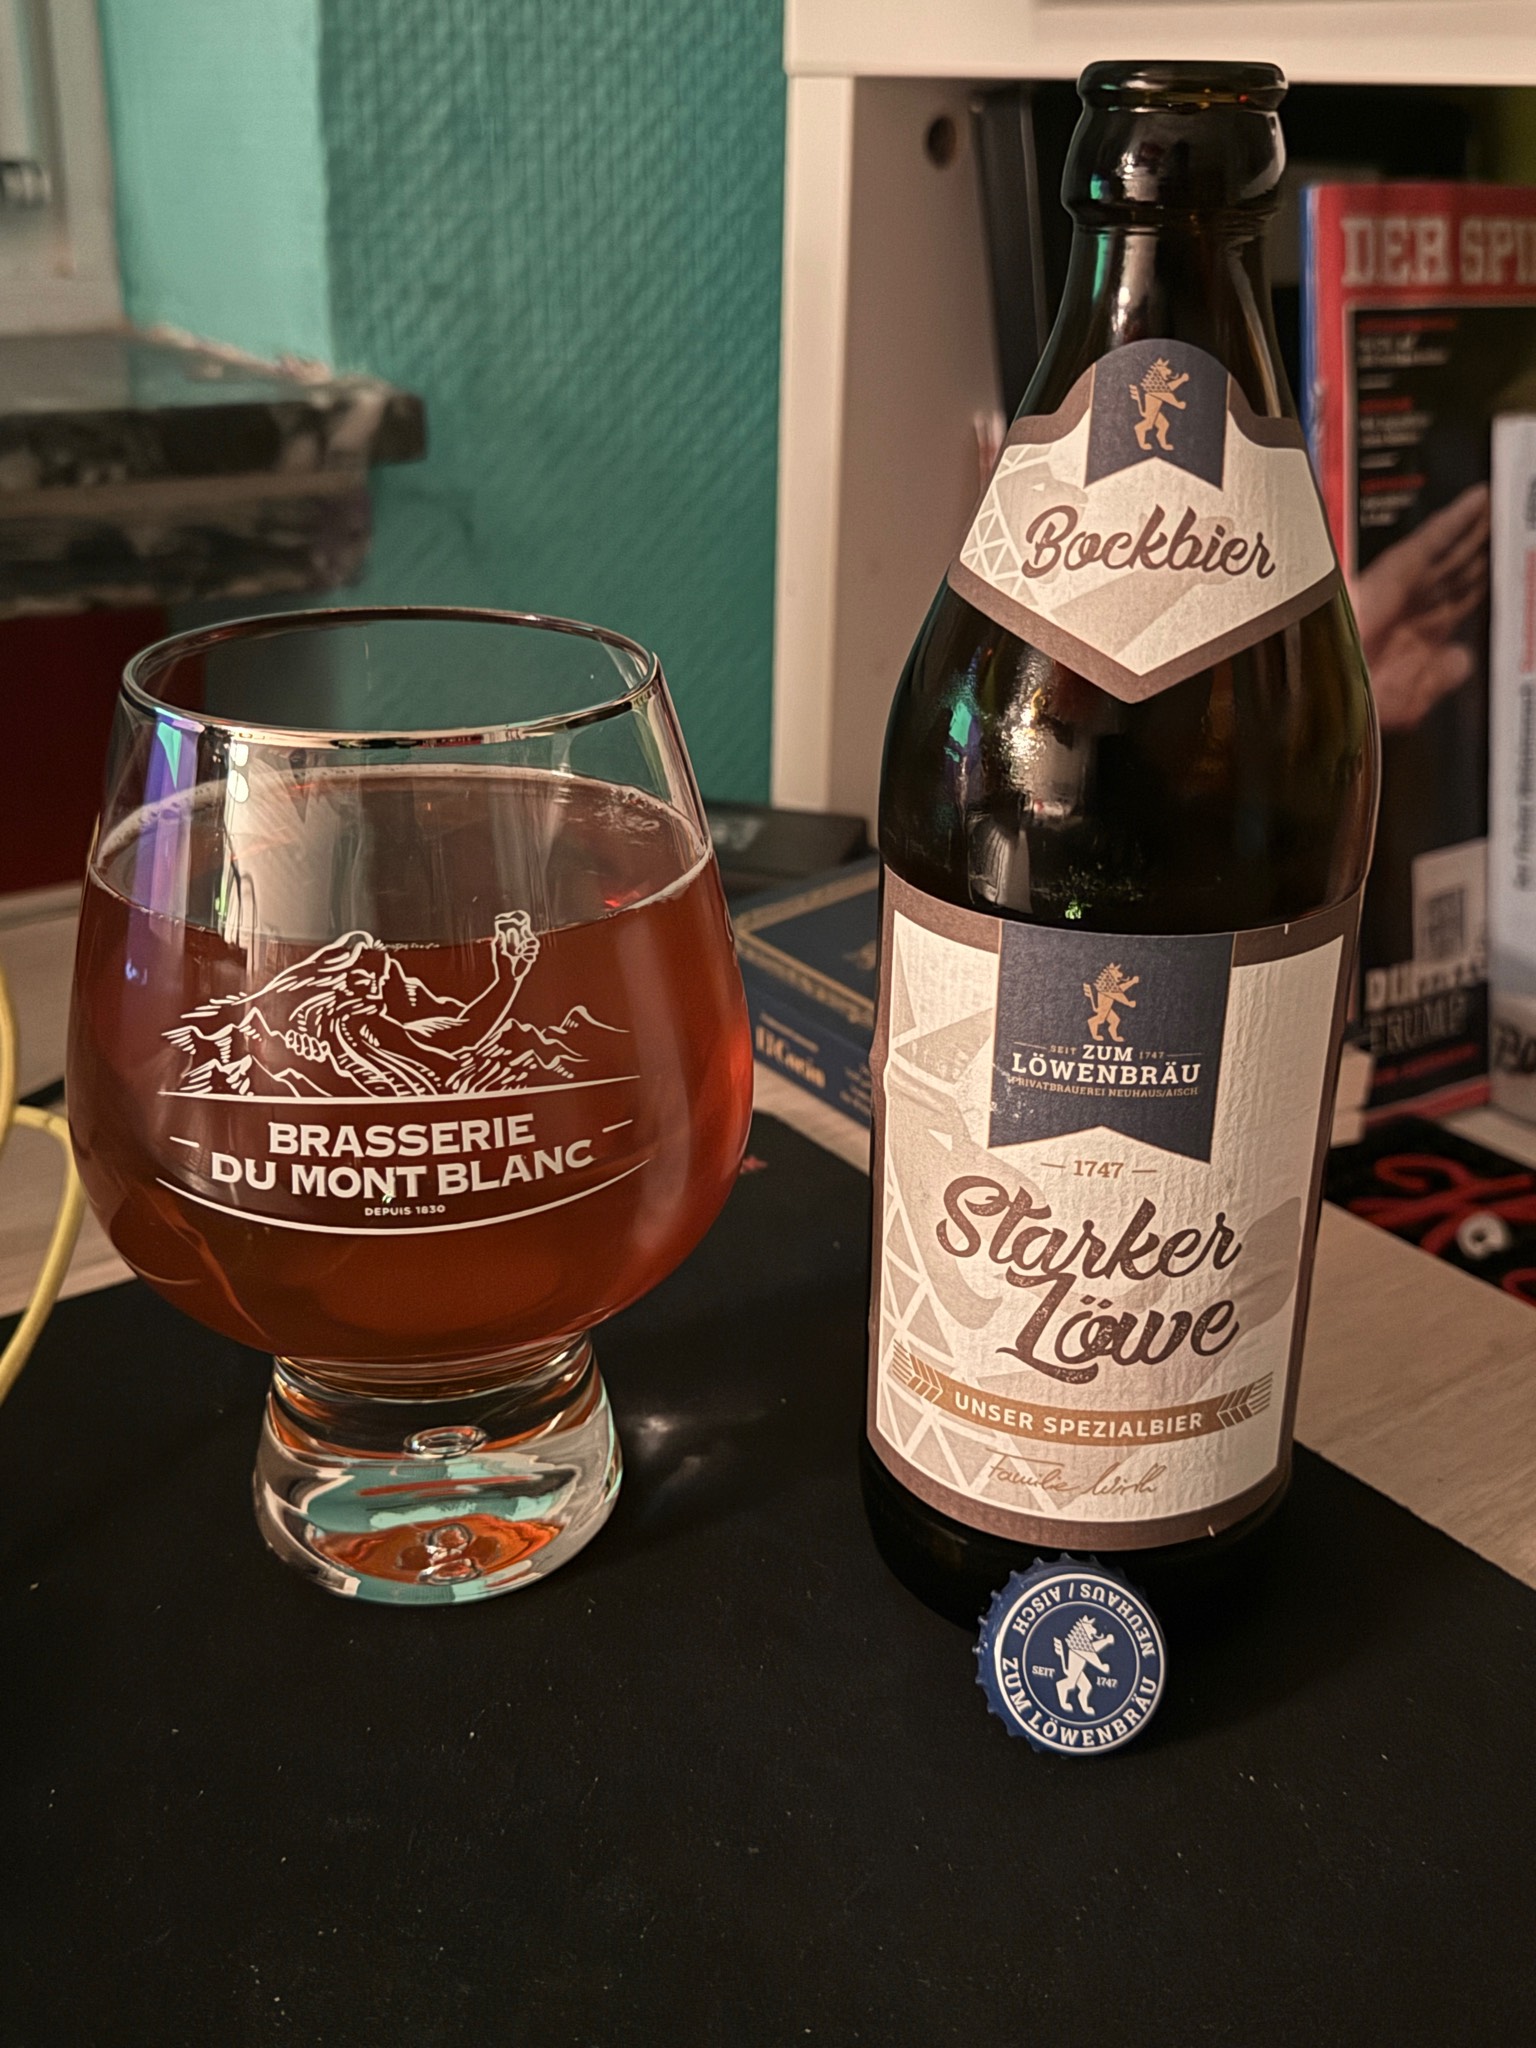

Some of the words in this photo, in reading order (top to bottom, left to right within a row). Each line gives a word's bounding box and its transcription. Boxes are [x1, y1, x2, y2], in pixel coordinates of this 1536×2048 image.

[1342, 217, 1449, 286] DER
[1459, 217, 1536, 285] SPI
[1021, 504, 1276, 580] Bockbier
[1012, 1052, 1201, 1085] LÖWENBRÄU
[1049, 1044, 1077, 1056] SEIT
[1082, 1044, 1133, 1062] ZUM
[1139, 1051, 1165, 1060] 1747
[1011, 1076, 1105, 1097] PRIVATBRAUEREI
[1108, 1085, 1199, 1098] NEUHAUS/AISCH
[268, 1113, 537, 1159] BRASSERIE
[211, 1152, 277, 1190] DU
[291, 1165, 427, 1200] MONT
[437, 1139, 597, 1196] BLANC
[1073, 1160, 1124, 1179] 1747
[364, 1206, 412, 1217] DEPUIS
[416, 1204, 446, 1215] 1830
[936, 1175, 1242, 1281] Starker
[995, 1264, 1240, 1385] Löwe
[954, 1391, 1034, 1430] UNSER
[1043, 1411, 1203, 1438] SPEZIALBIER
[1012, 1586, 1061, 1636] AISCH
[1080, 1583, 1156, 1659] NEUHAUS
[1032, 1665, 1056, 1679] SEIT
[1096, 1676, 1118, 1689] 1747
[1002, 1657, 1032, 1714] ZUM
[1028, 1676, 1158, 1747] LÖWENBRÄU
